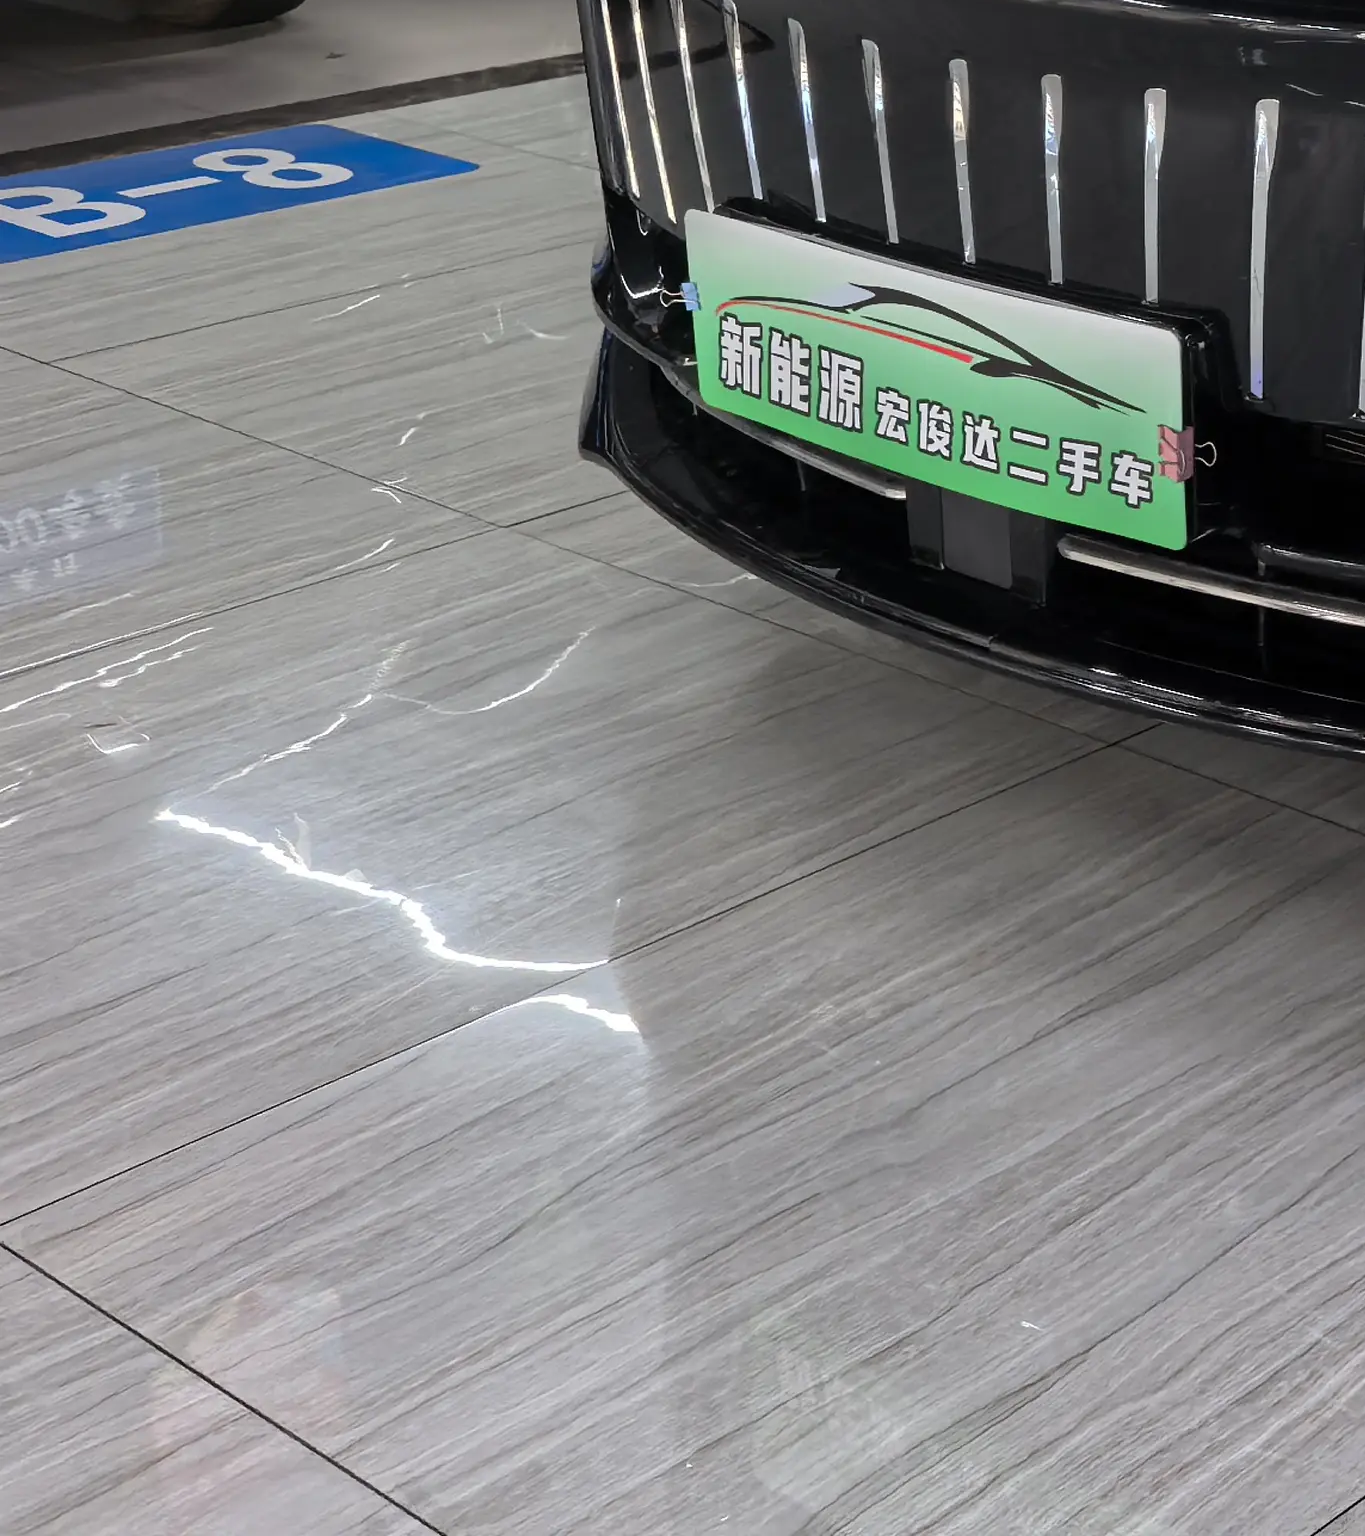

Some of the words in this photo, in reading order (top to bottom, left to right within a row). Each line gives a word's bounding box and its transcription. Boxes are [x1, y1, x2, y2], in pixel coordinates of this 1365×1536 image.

[718, 311, 863, 434] 新能源
[874, 386, 1155, 509] 宏俊达二手车
